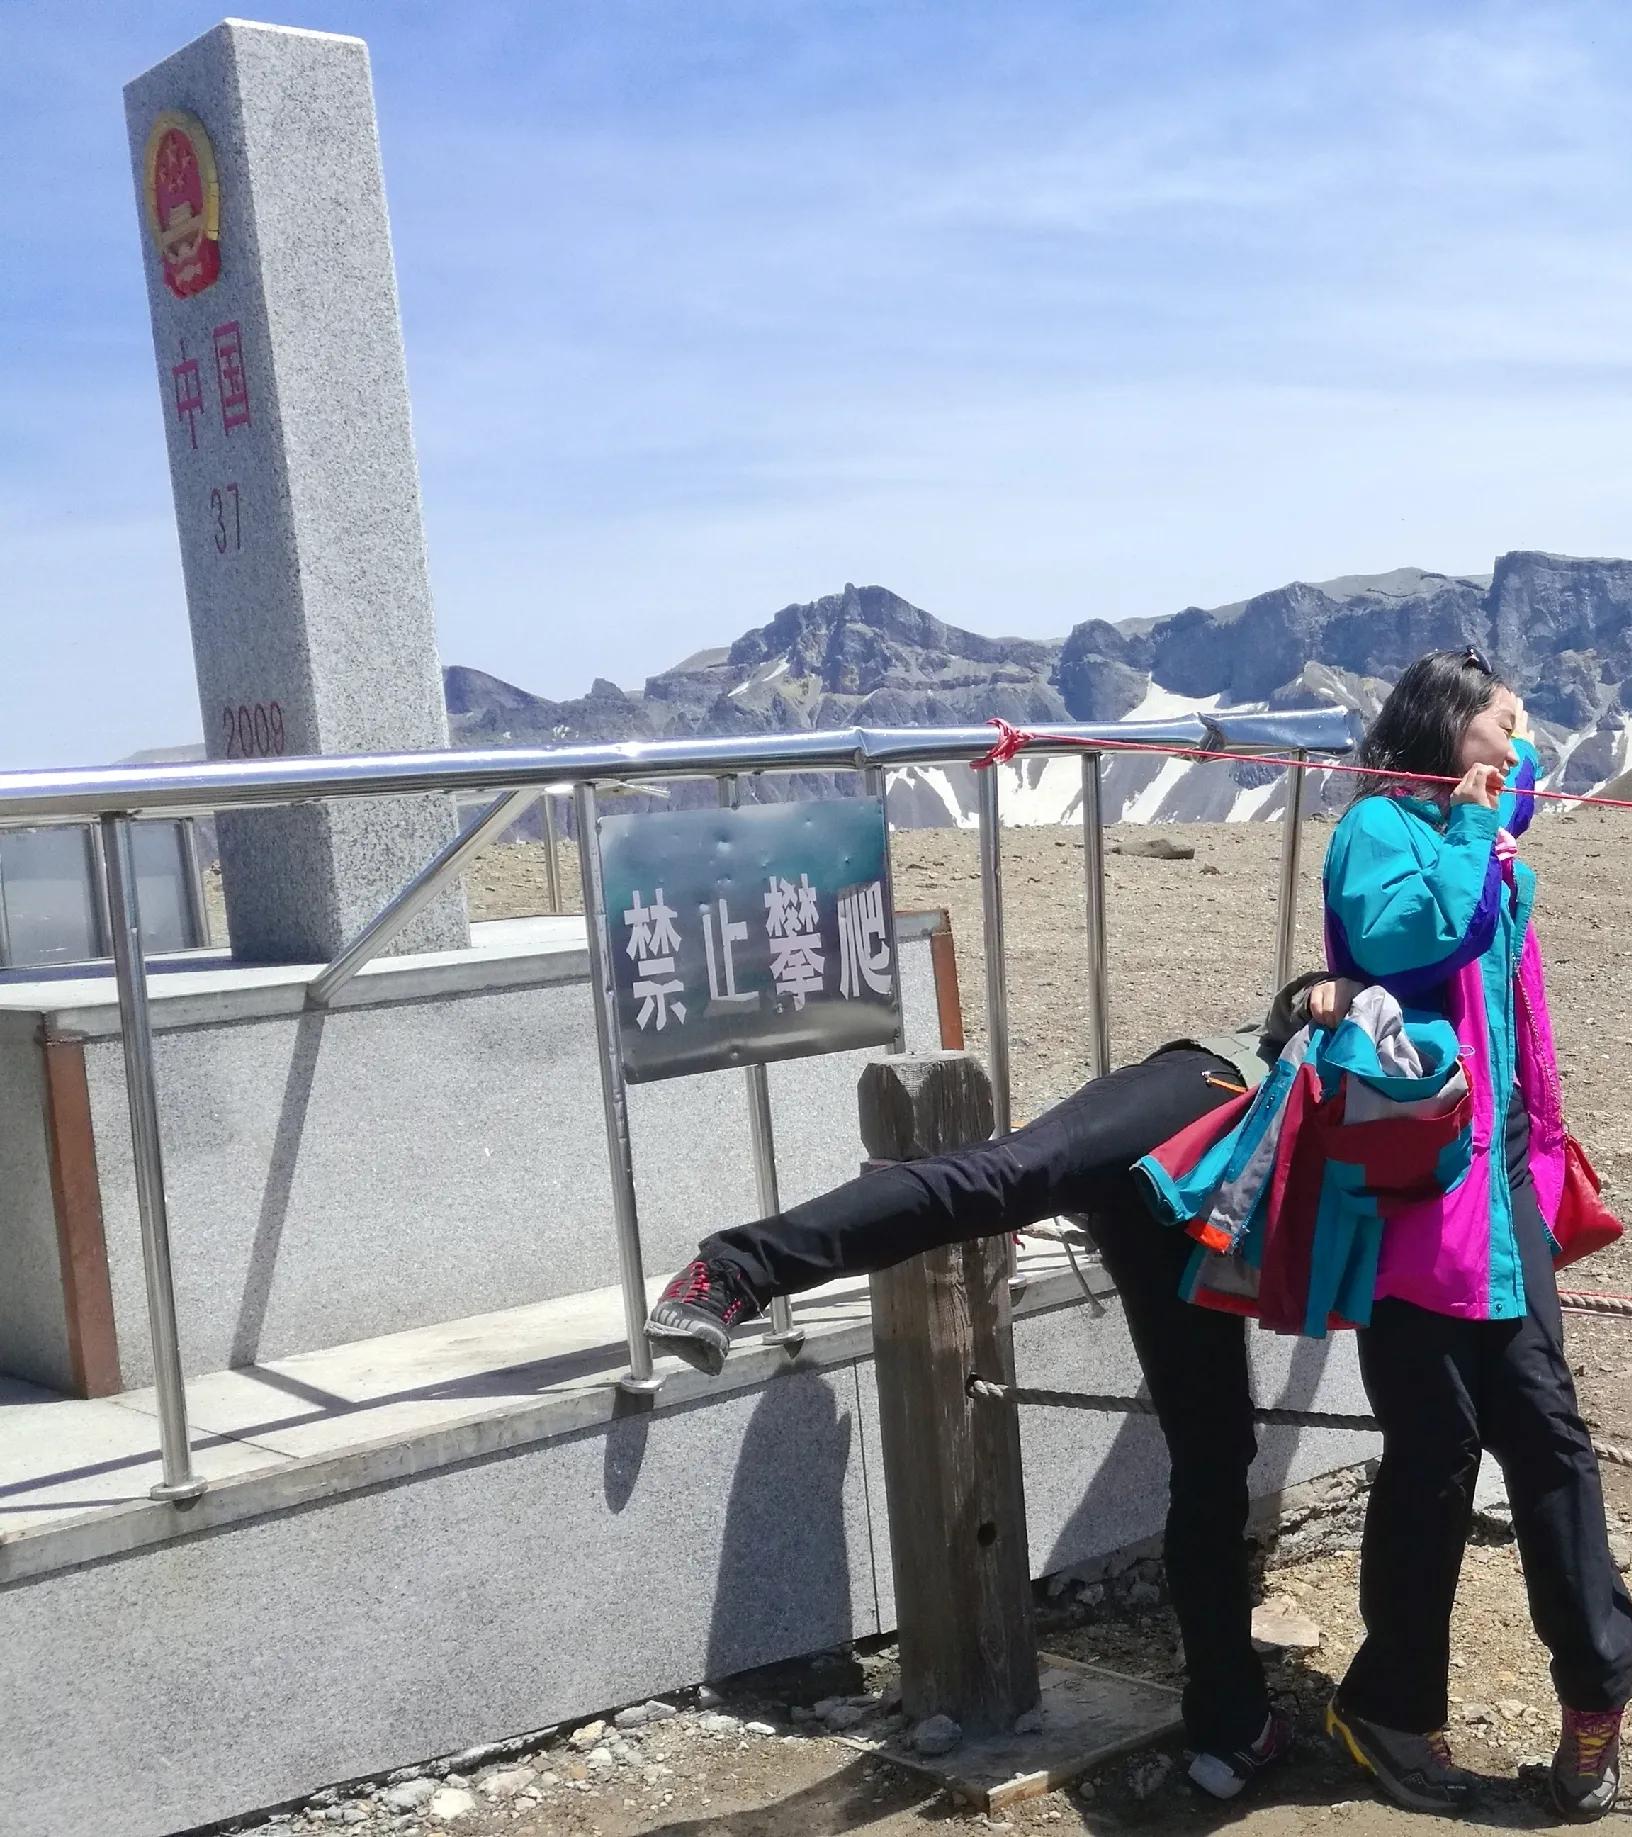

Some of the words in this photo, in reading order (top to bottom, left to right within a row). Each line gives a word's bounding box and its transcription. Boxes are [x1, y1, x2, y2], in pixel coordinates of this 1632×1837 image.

[172, 320, 251, 449] 中国
[211, 483, 240, 554] 37
[223, 701, 284, 759] 2009
[624, 873, 892, 1031] 禁止攀爬
